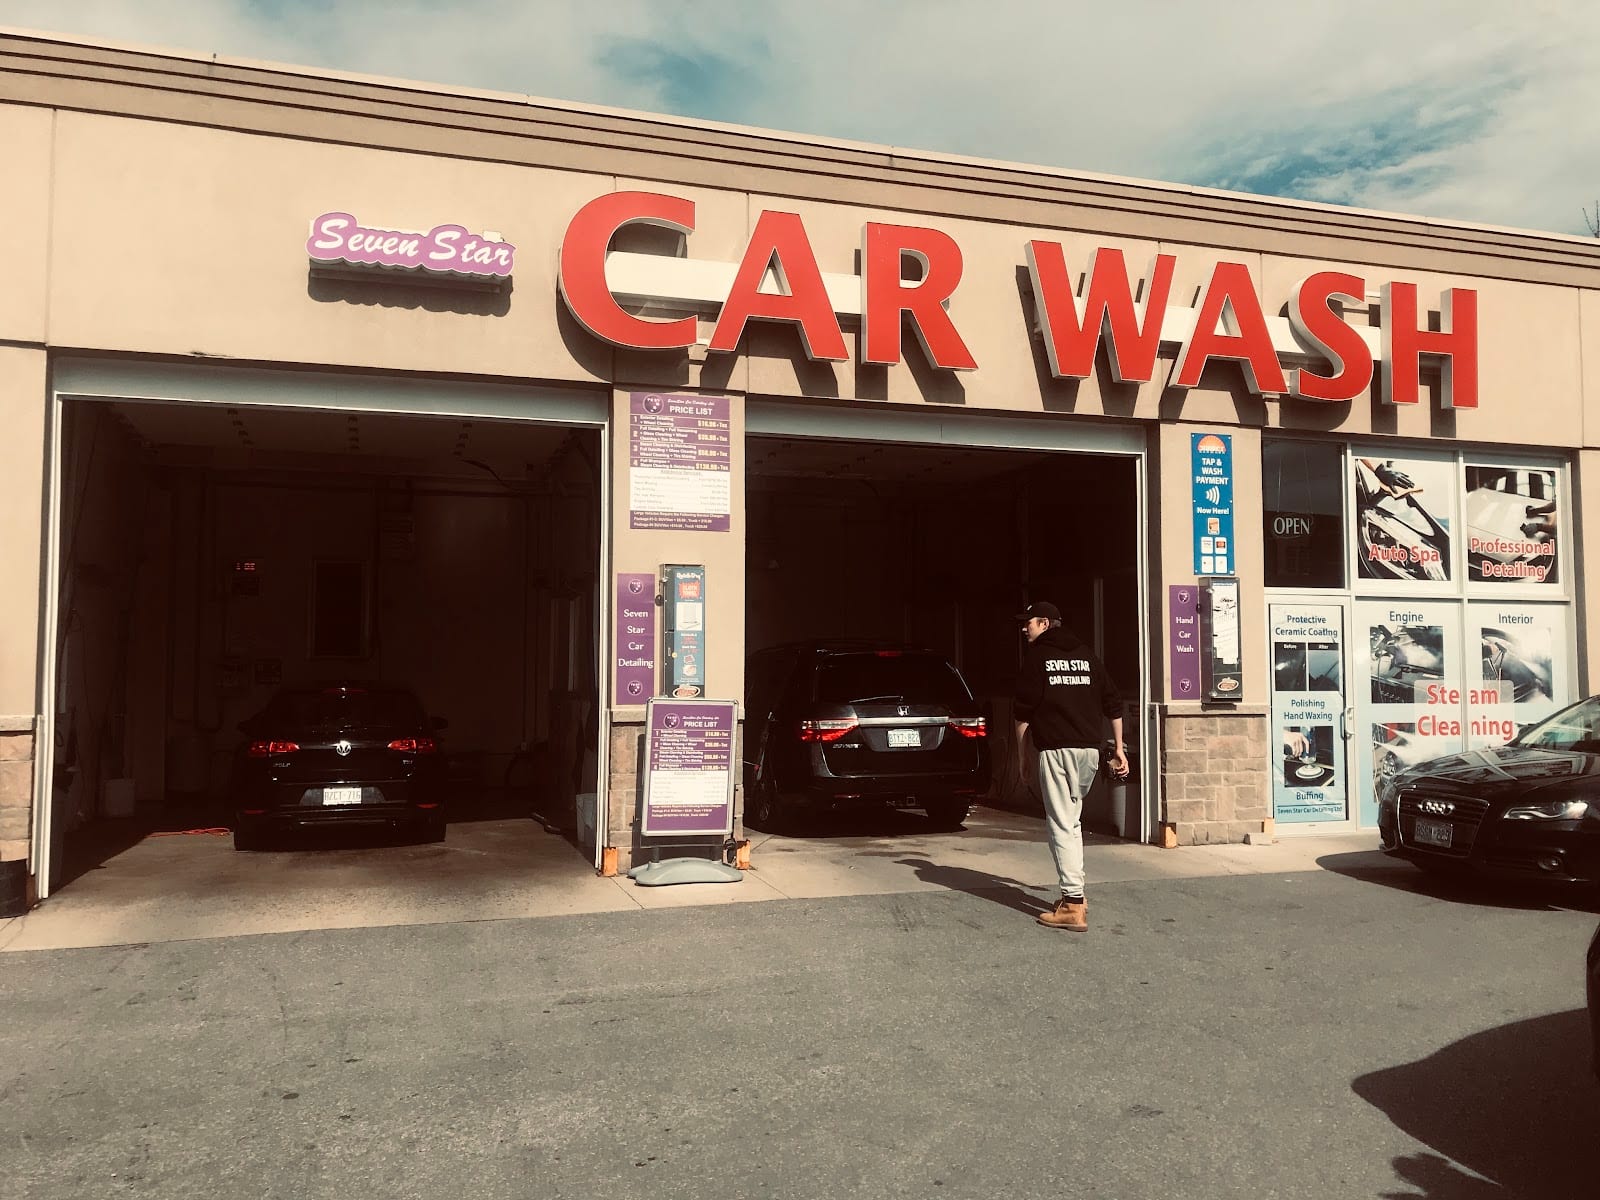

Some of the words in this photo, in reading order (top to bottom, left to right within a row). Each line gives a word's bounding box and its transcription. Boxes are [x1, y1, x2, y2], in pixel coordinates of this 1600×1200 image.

[314, 218, 420, 256] Seven
[429, 230, 511, 266] Star
[560, 191, 979, 370] CAR
[1027, 239, 1478, 409] WASH
[670, 406, 694, 414] PRICE
[1202, 467, 1222, 475] WASH
[1196, 476, 1228, 485] PAYMENT
[1274, 517, 1310, 536] OPEN
[1471, 537, 1555, 556] Professional
[1368, 544, 1407, 562] Auto
[1410, 546, 1440, 566] Spa
[1482, 561, 1546, 581] Detailing
[623, 609, 648, 618] Seven
[1389, 610, 1424, 624] Engine
[1498, 613, 1534, 624] Interior
[1287, 615, 1327, 624] Protective
[627, 626, 645, 634] Star
[1275, 627, 1306, 636] Ceramic
[1308, 628, 1338, 638] Coating
[628, 642, 644, 650] Car
[618, 658, 654, 668] Detailing
[1046, 660, 1070, 671] SEVEN
[1071, 660, 1090, 672] STAR
[1049, 676, 1062, 685] CAR
[1291, 699, 1325, 710] Polishing
[1284, 711, 1304, 720] Hand
[1305, 711, 1333, 722] Waxing
[1417, 716, 1514, 740] Cleaning
[1296, 791, 1324, 801] Buffing
